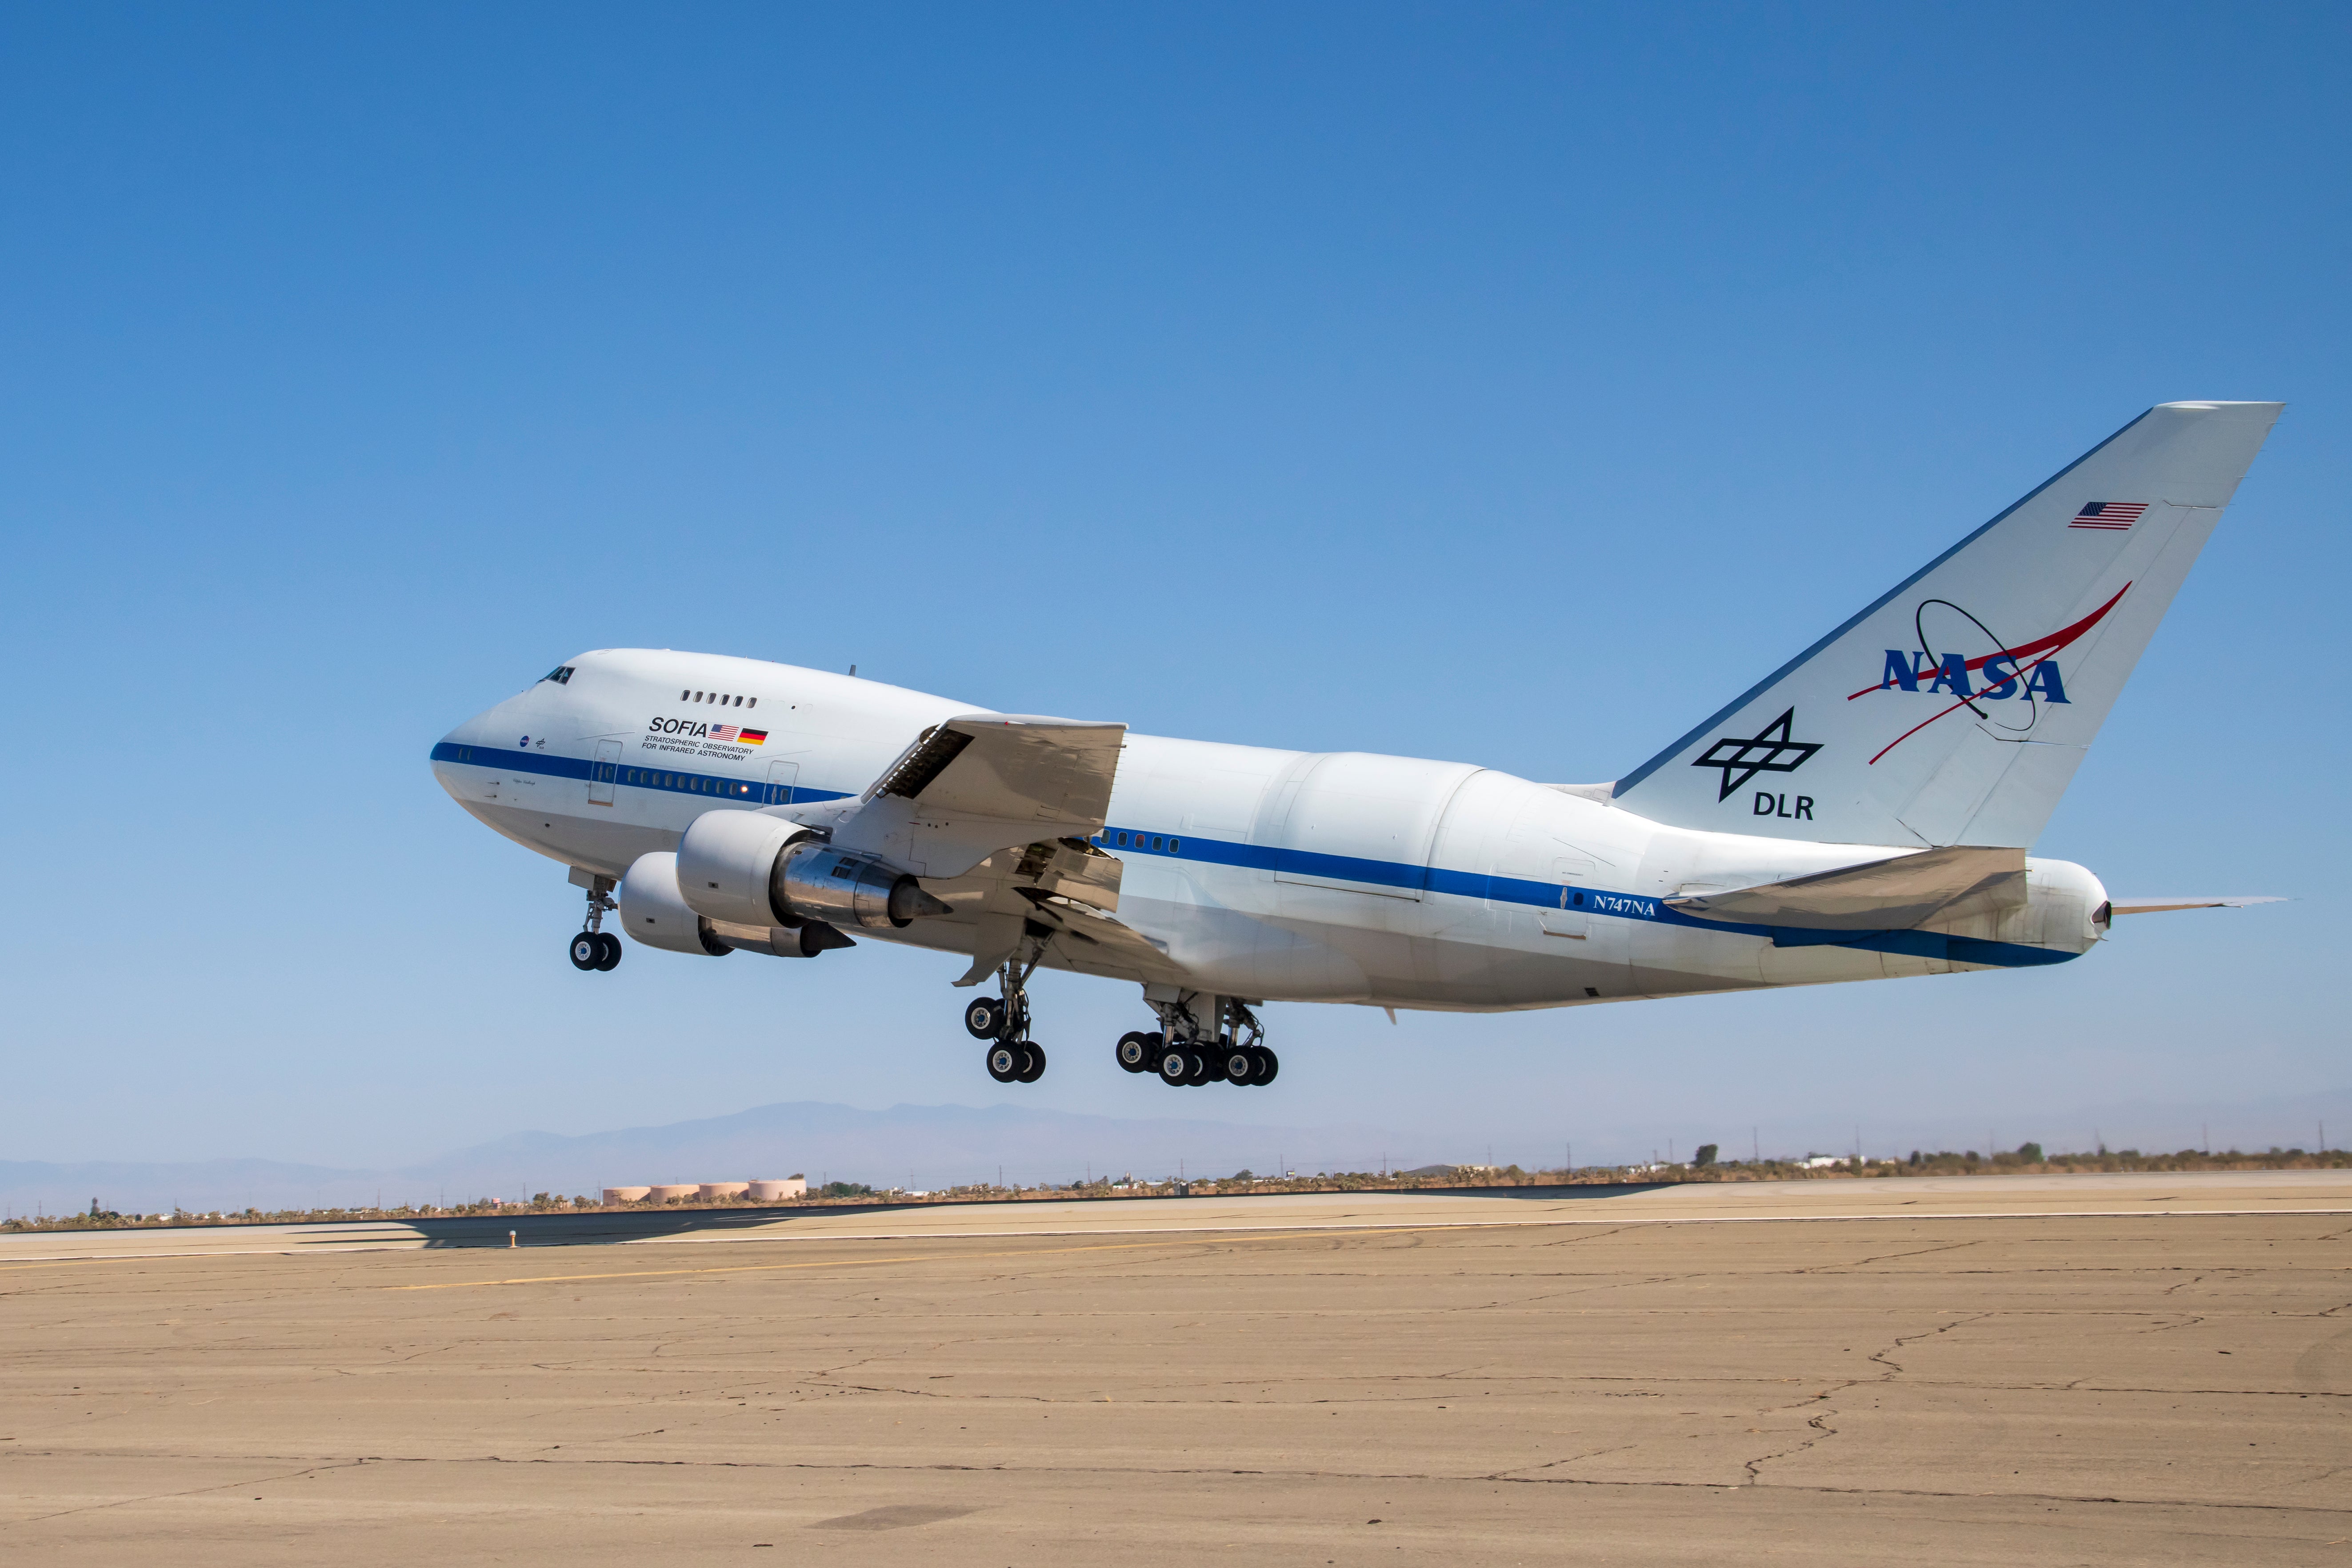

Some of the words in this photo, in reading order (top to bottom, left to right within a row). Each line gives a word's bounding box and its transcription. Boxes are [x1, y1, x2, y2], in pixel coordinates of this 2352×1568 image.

[1879, 649, 2072, 704] NASA
[649, 717, 707, 738] SOFIA
[644, 735, 700, 747] STRATOSPHERIC
[703, 743, 754, 755] OBSERVATORY
[659, 744, 695, 754] INFRARED
[697, 750, 745, 761] ASTRONOMY
[1753, 792, 1814, 820] DLR
[1593, 895, 1656, 916] N747NA
